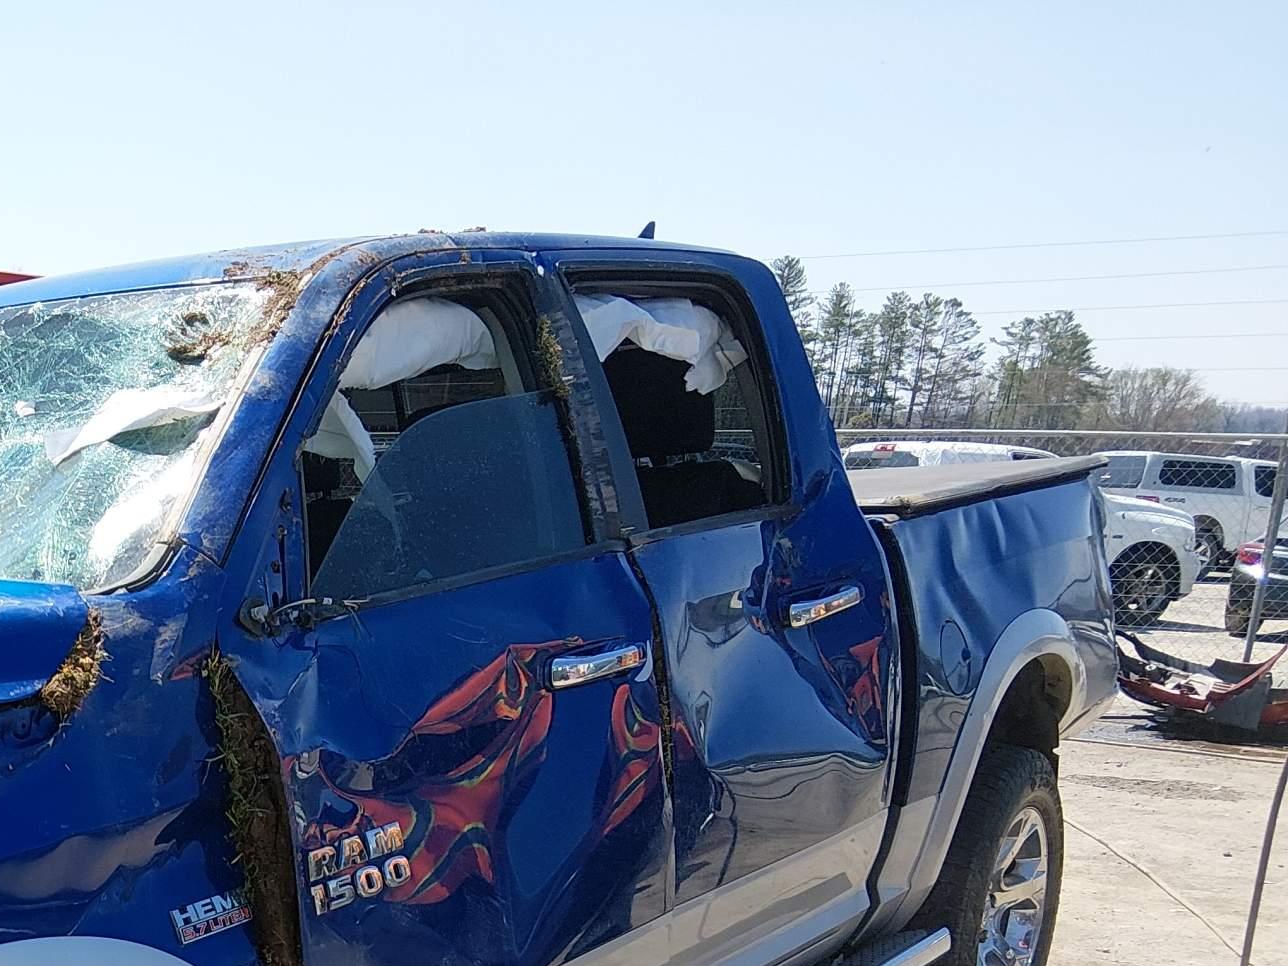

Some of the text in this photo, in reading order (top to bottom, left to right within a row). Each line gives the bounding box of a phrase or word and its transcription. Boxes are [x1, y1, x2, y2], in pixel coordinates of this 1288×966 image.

[308, 821, 404, 881] RAM
[310, 855, 411, 916] 1500
[182, 920, 208, 940] 5.7
